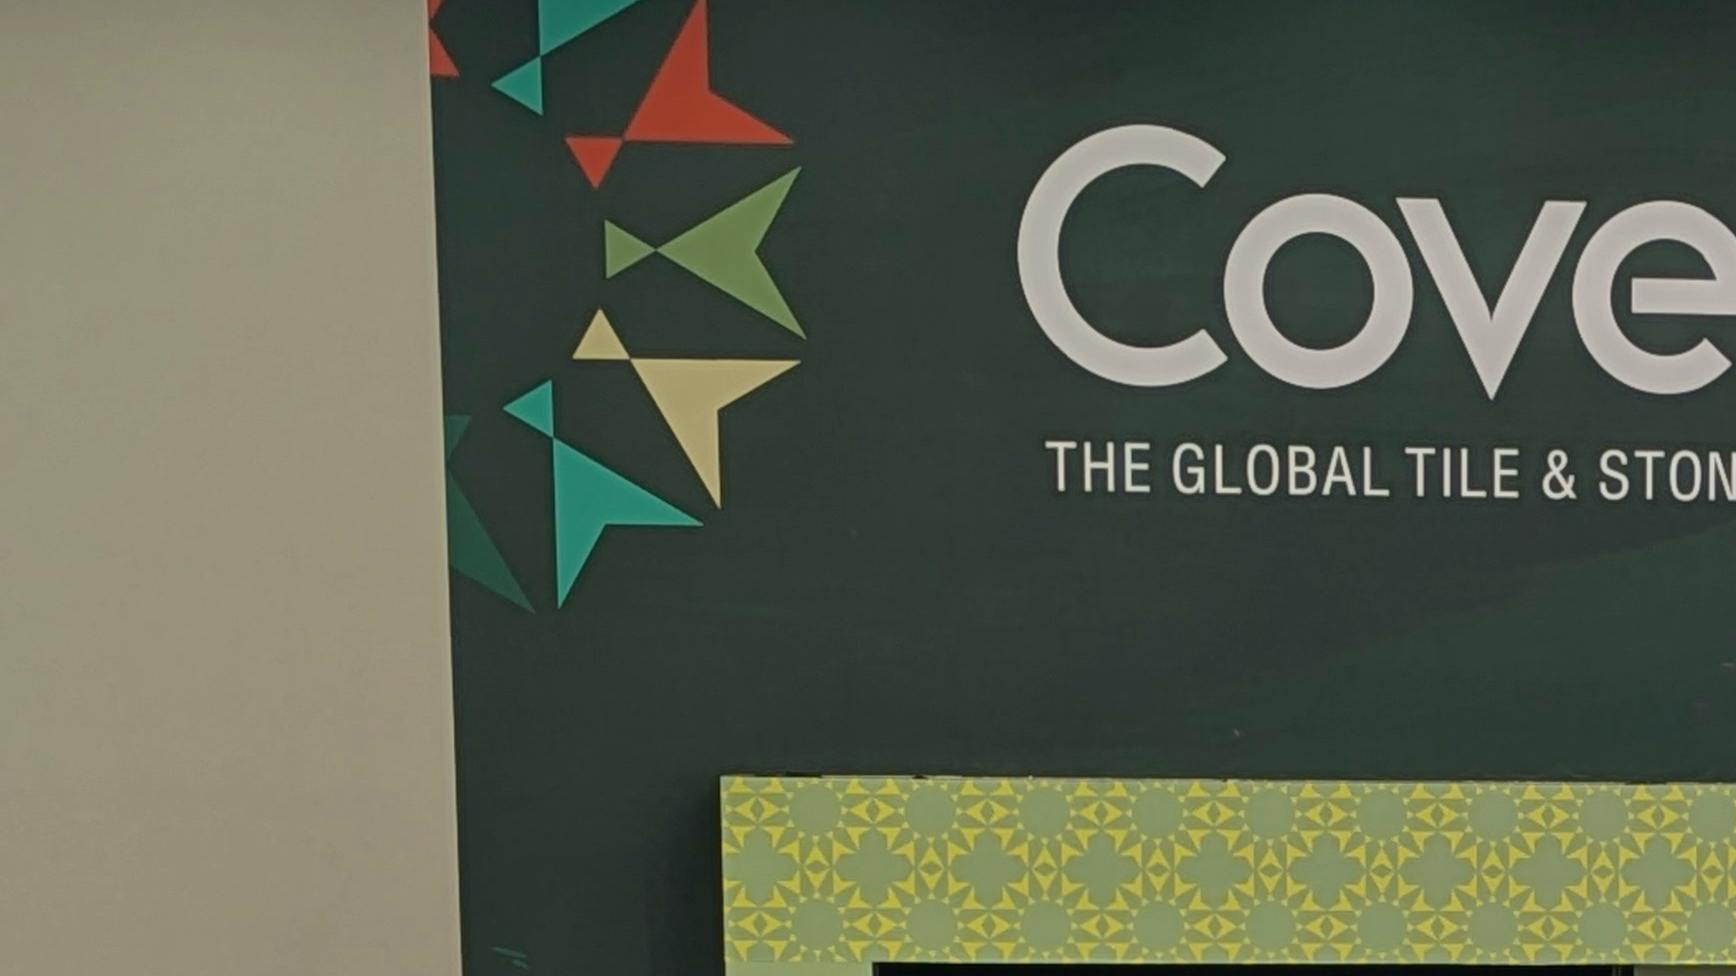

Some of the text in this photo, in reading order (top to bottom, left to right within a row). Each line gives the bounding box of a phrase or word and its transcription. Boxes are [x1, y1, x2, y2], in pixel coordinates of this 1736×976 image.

[1044, 440, 1153, 495] THE
[1170, 441, 1391, 500] GLOBAL
[1406, 446, 1521, 501] TILE
[1541, 448, 1579, 503] &
